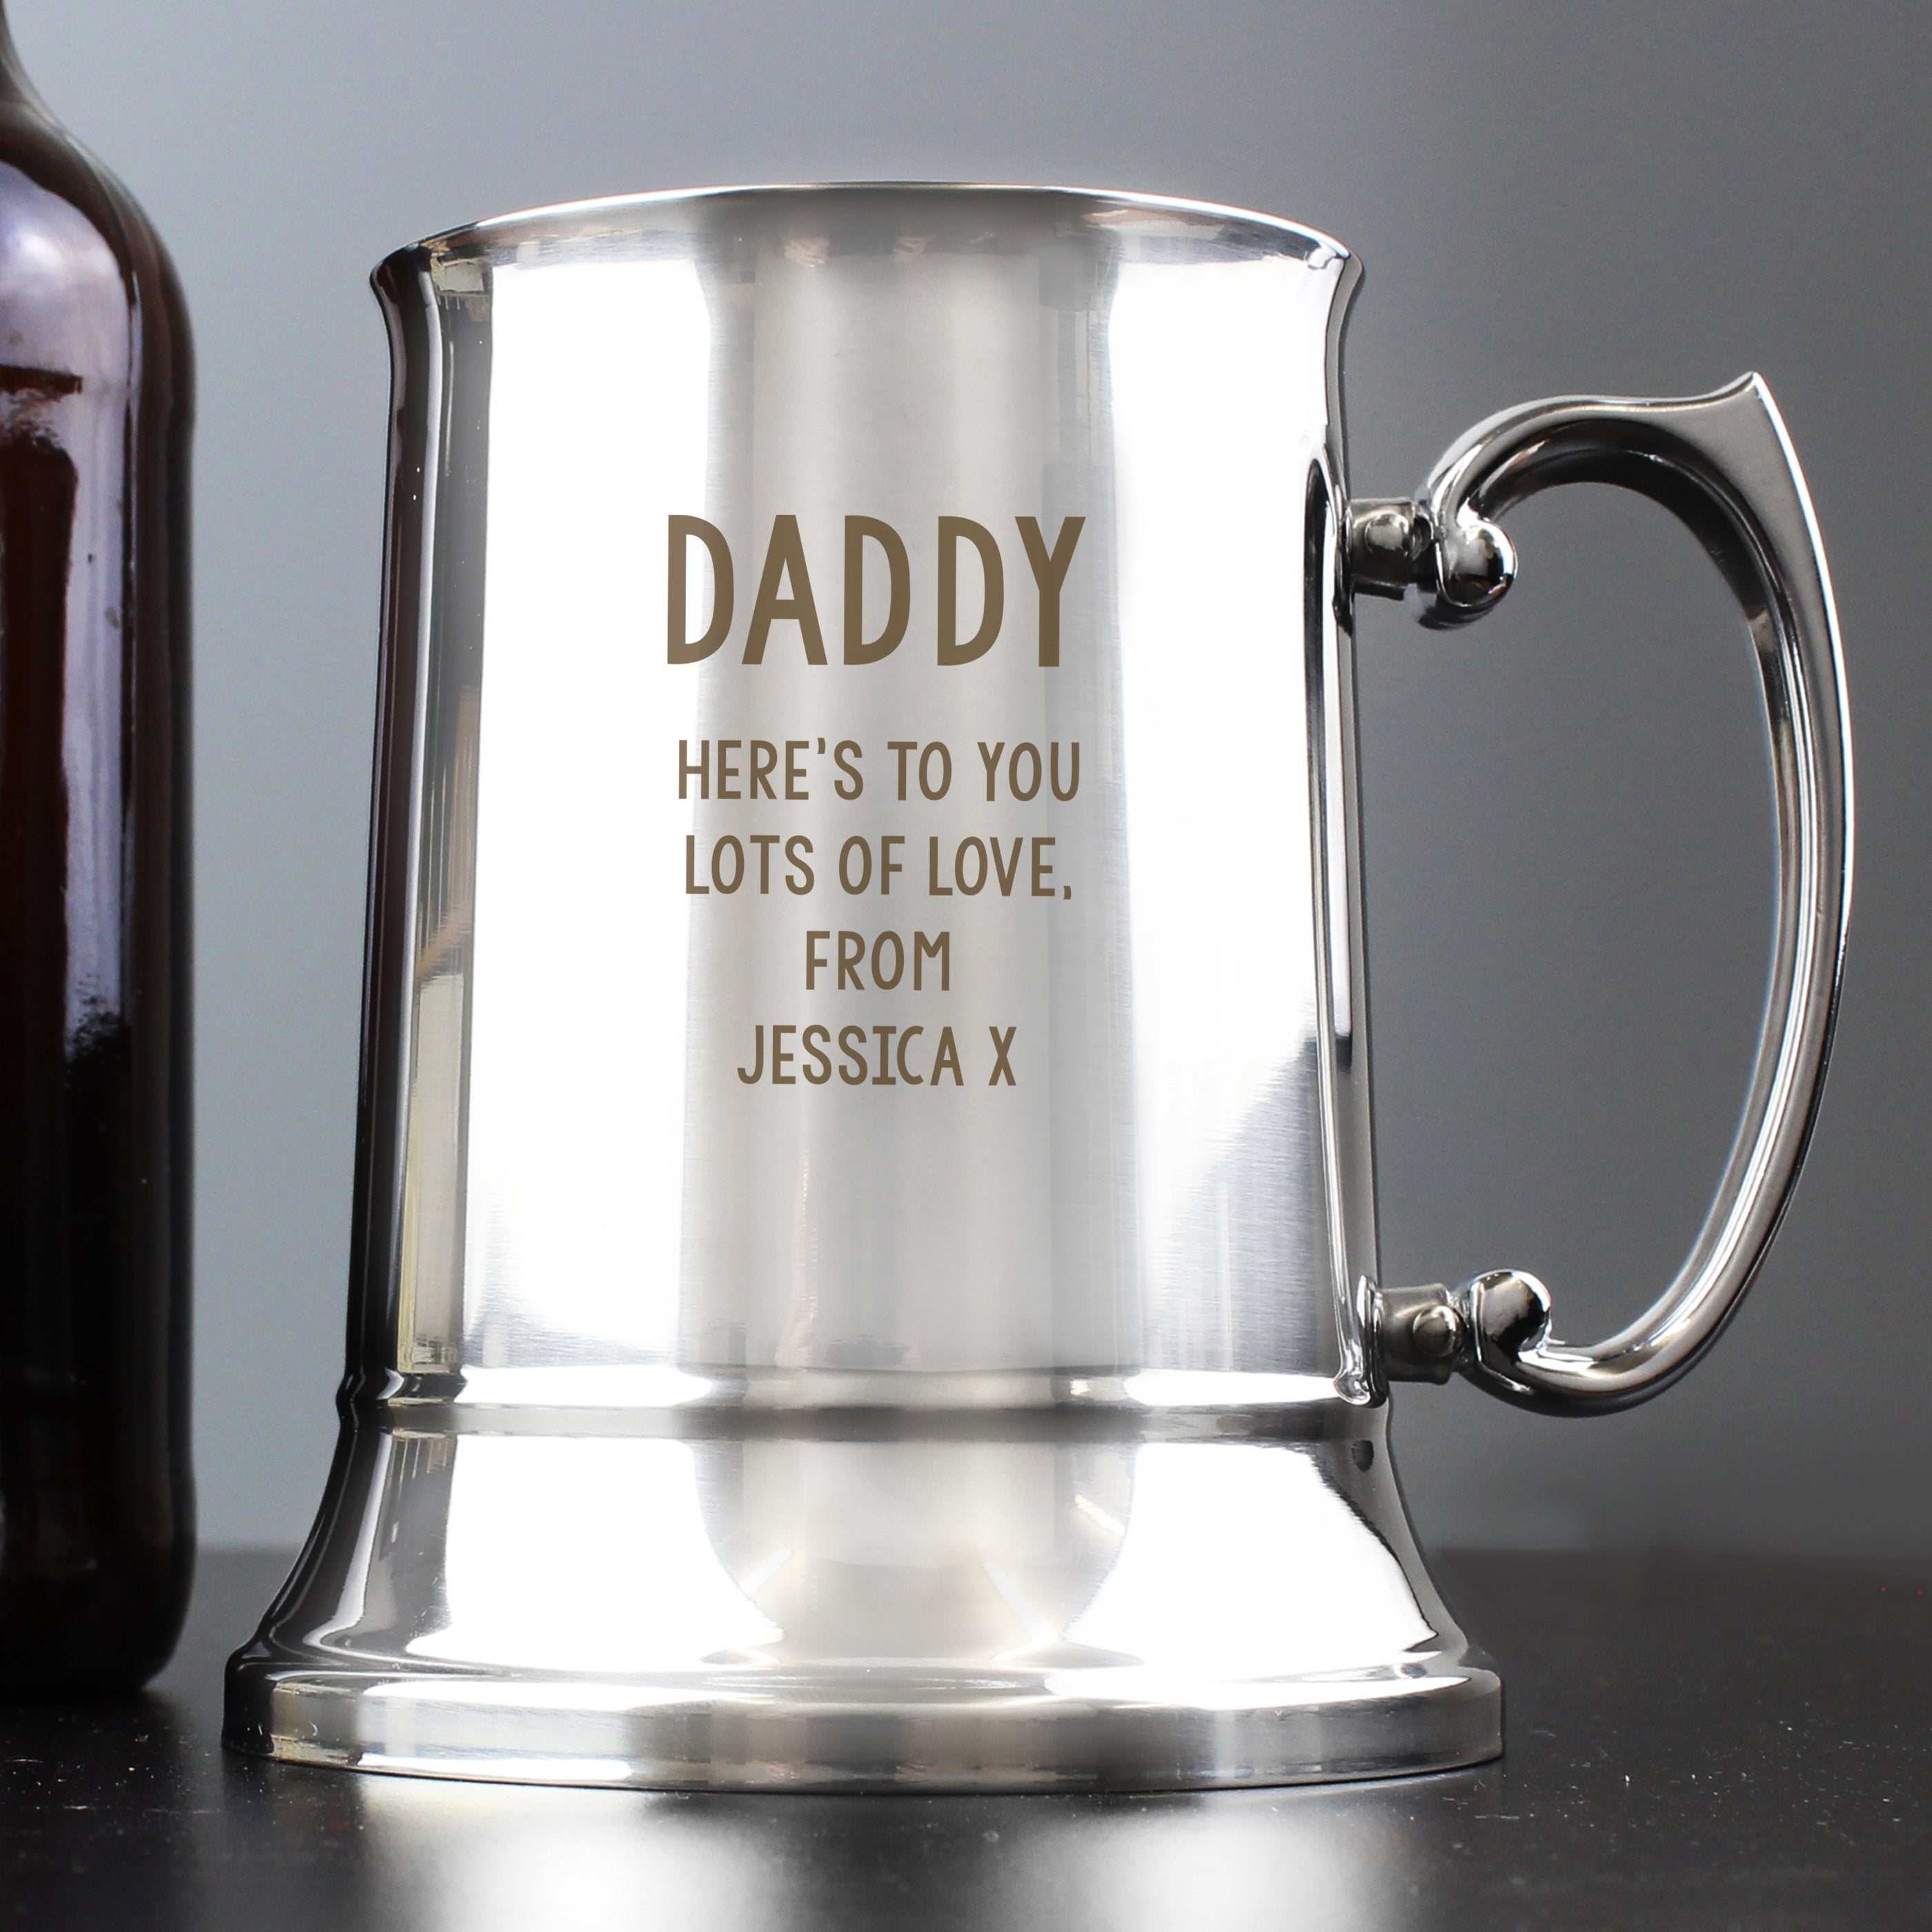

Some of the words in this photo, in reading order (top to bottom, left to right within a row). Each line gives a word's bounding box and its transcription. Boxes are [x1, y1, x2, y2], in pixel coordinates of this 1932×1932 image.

[667, 514, 1086, 667] DADDY
[678, 737, 864, 801] HERE'S
[887, 741, 952, 801] TO
[977, 742, 1080, 802] YOU
[685, 834, 815, 895] LOTS
[838, 836, 906, 895] OF
[929, 836, 1072, 900] LOVE,
[805, 930, 951, 992] FROM
[737, 1024, 964, 1087] JESSICA
[989, 1026, 1017, 1087] X
